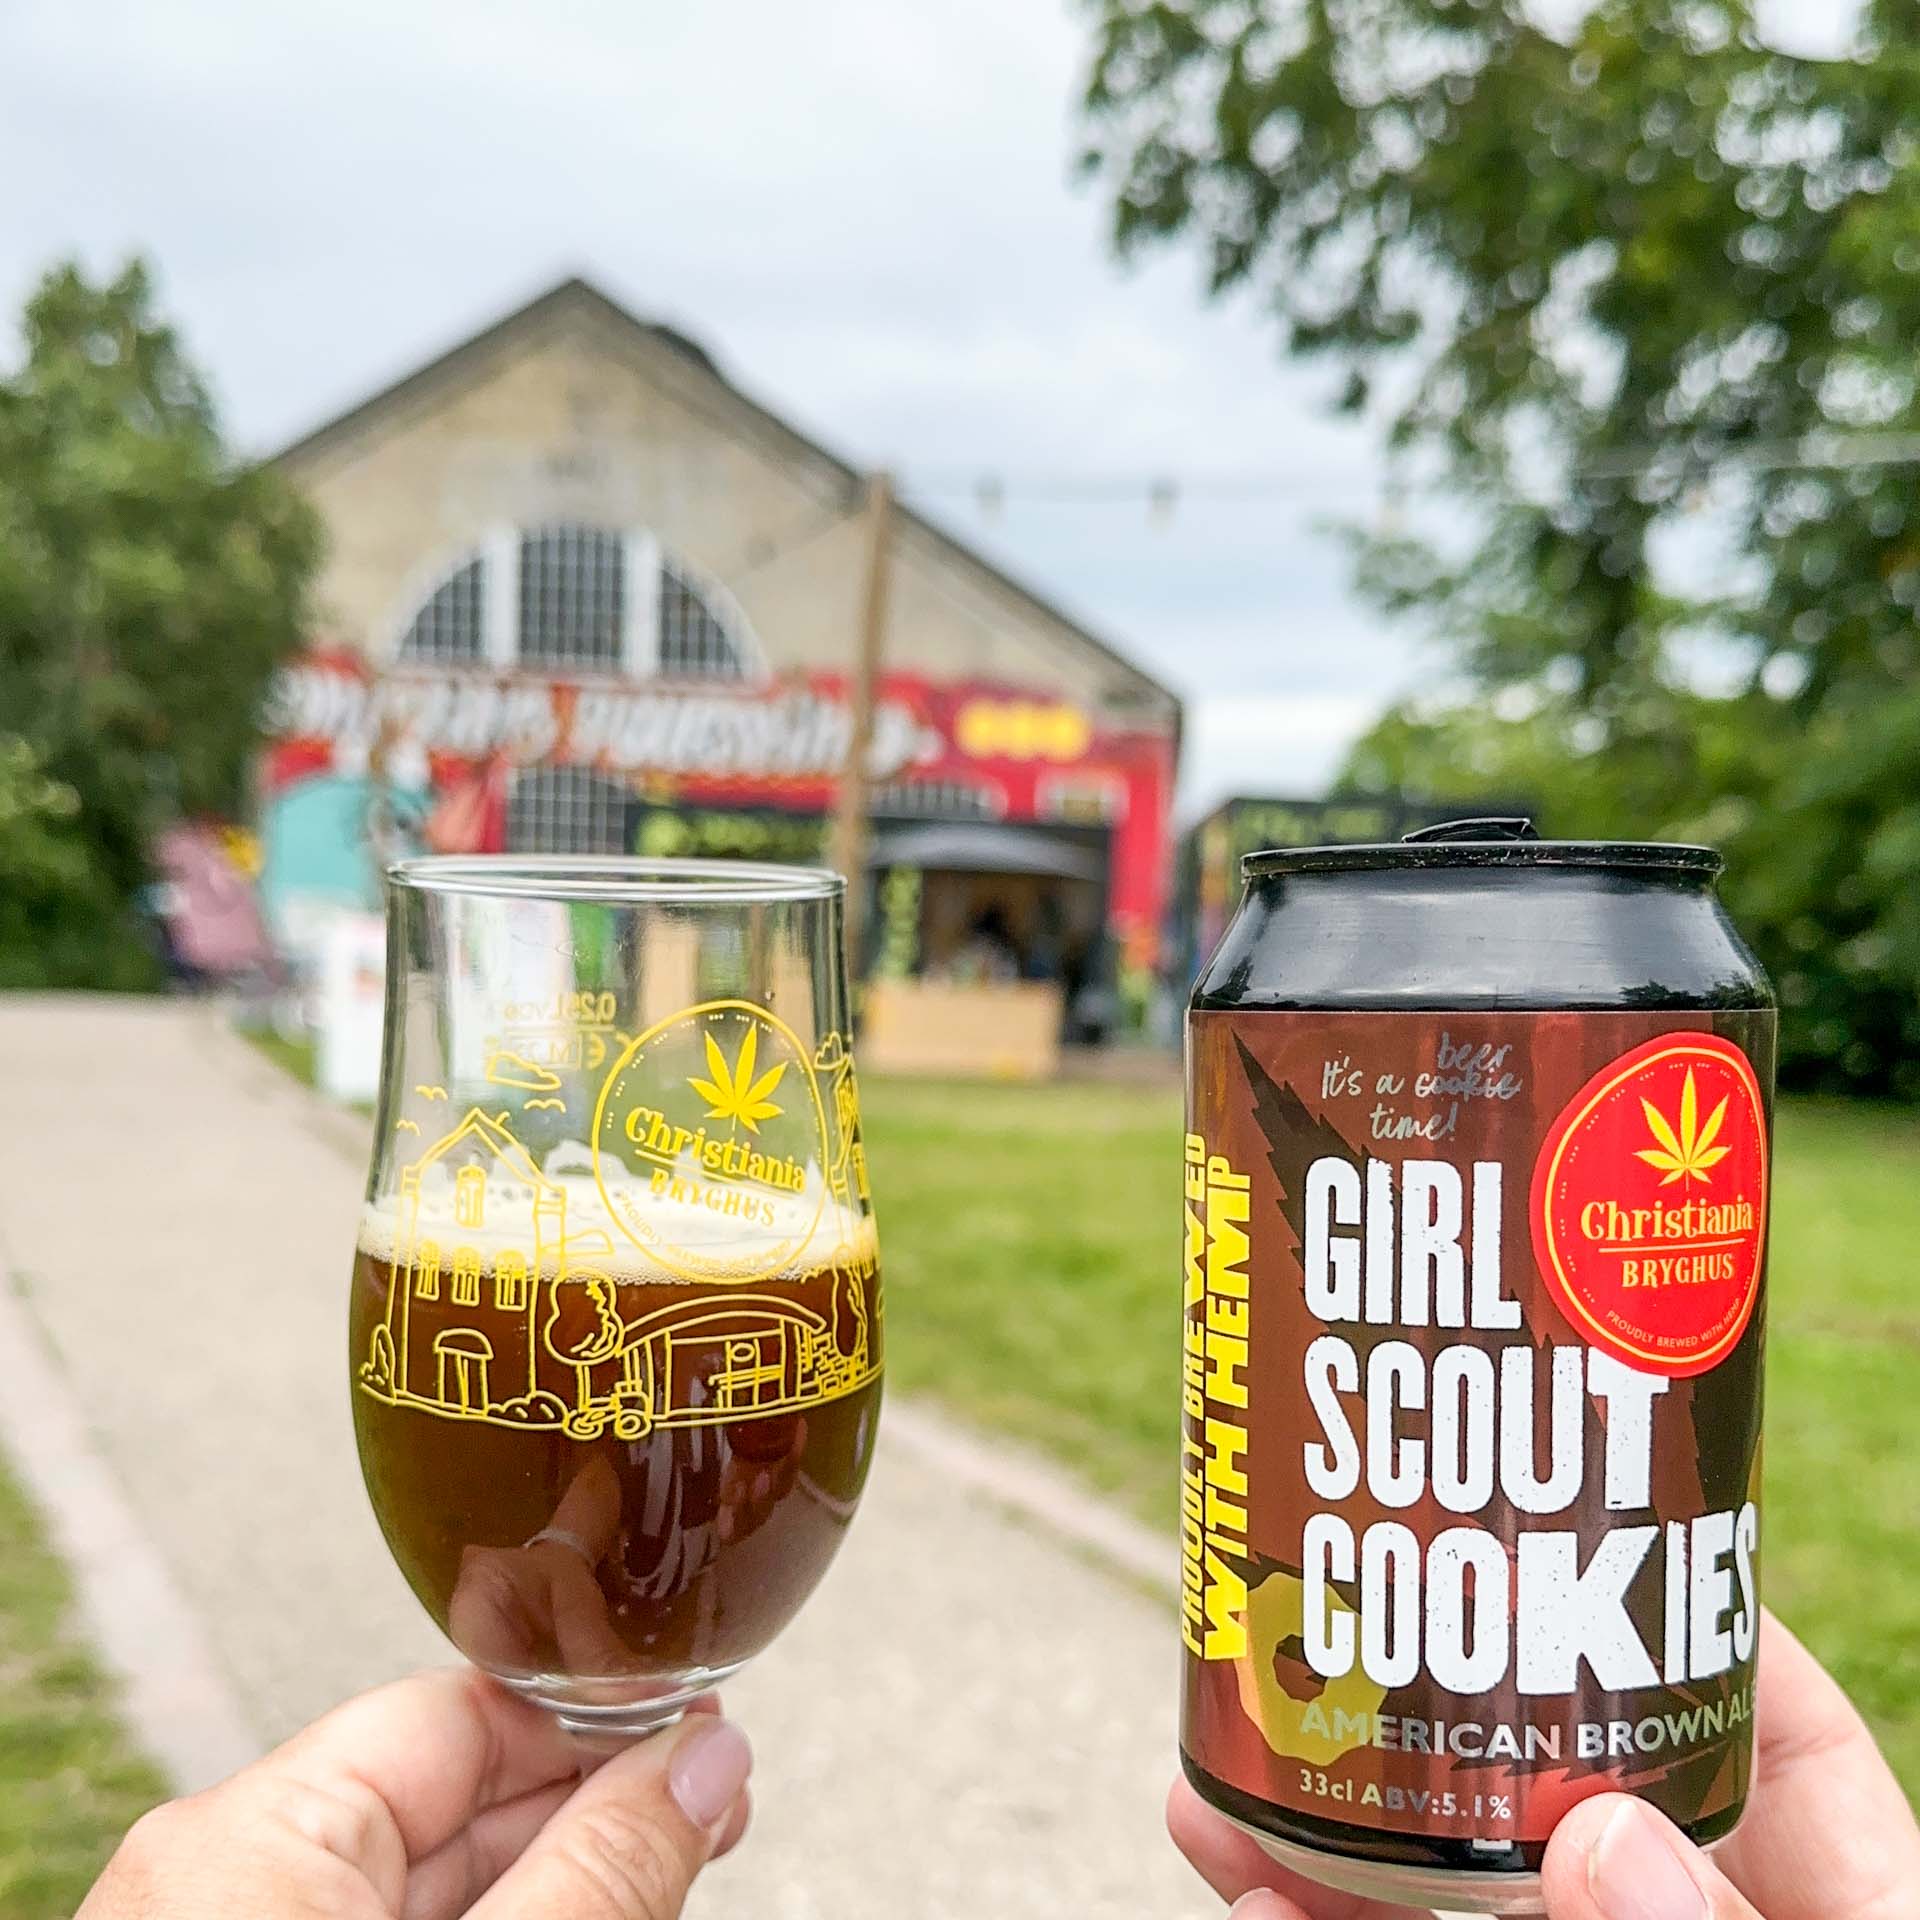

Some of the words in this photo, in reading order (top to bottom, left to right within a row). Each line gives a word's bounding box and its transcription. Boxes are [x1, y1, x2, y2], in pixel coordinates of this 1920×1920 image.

[1321, 1055, 1363, 1099] It's
[1376, 1073, 1405, 1095] a
[1437, 1031, 1513, 1071] beer
[624, 1106, 808, 1193] Christiania
[1369, 1101, 1459, 1142] time!
[649, 1167, 776, 1228] BRYGHUS
[1580, 1194, 1754, 1242] Christiania
[1304, 1156, 1522, 1330] GIRL
[1621, 1253, 1735, 1289] BRYGHUS
[1182, 1132, 1207, 1421] BREWED
[1205, 1154, 1251, 1410] HEMP
[1606, 1310, 1655, 1343] PROUDLY
[1656, 1335, 1698, 1348] BREWED
[1700, 1324, 1723, 1342] WITH
[1303, 1336, 1670, 1514] SCOUT
[1182, 1426, 1204, 1658] PROUDLY
[1204, 1416, 1249, 1660] WITH
[1302, 1501, 1758, 1695] COOKIES
[1299, 1702, 1561, 1760] AMERICAN
[1576, 1700, 1724, 1759] BROWN
[1299, 1768, 1353, 1801] 33cl
